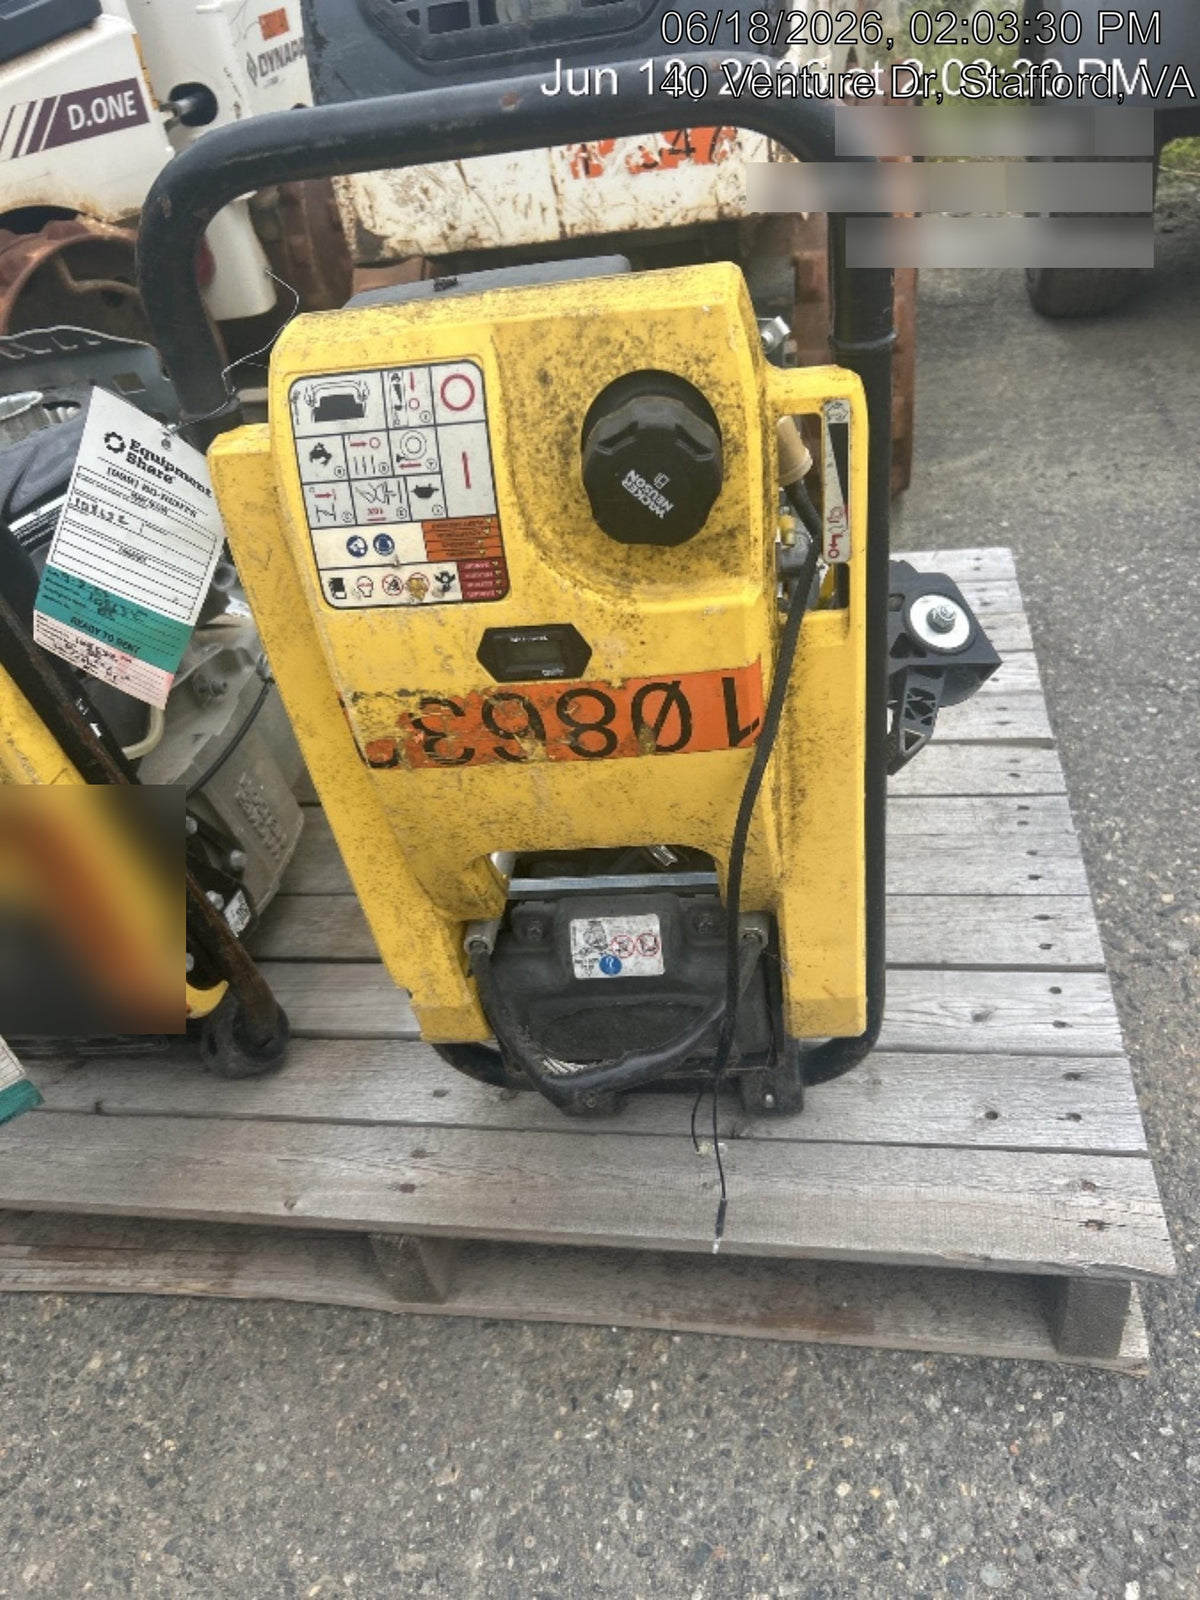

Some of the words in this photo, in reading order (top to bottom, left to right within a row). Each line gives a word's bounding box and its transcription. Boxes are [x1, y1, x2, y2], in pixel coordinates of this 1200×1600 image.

[67, 90, 137, 130] D.ONE
[126, 451, 174, 484] Share
[129, 438, 212, 498] Equipment
[622, 480, 664, 519] WACKER
[625, 469, 674, 512] NEUSON
[71, 616, 101, 636] READY
[103, 630, 115, 643] TO
[117, 637, 141, 654] RENT
